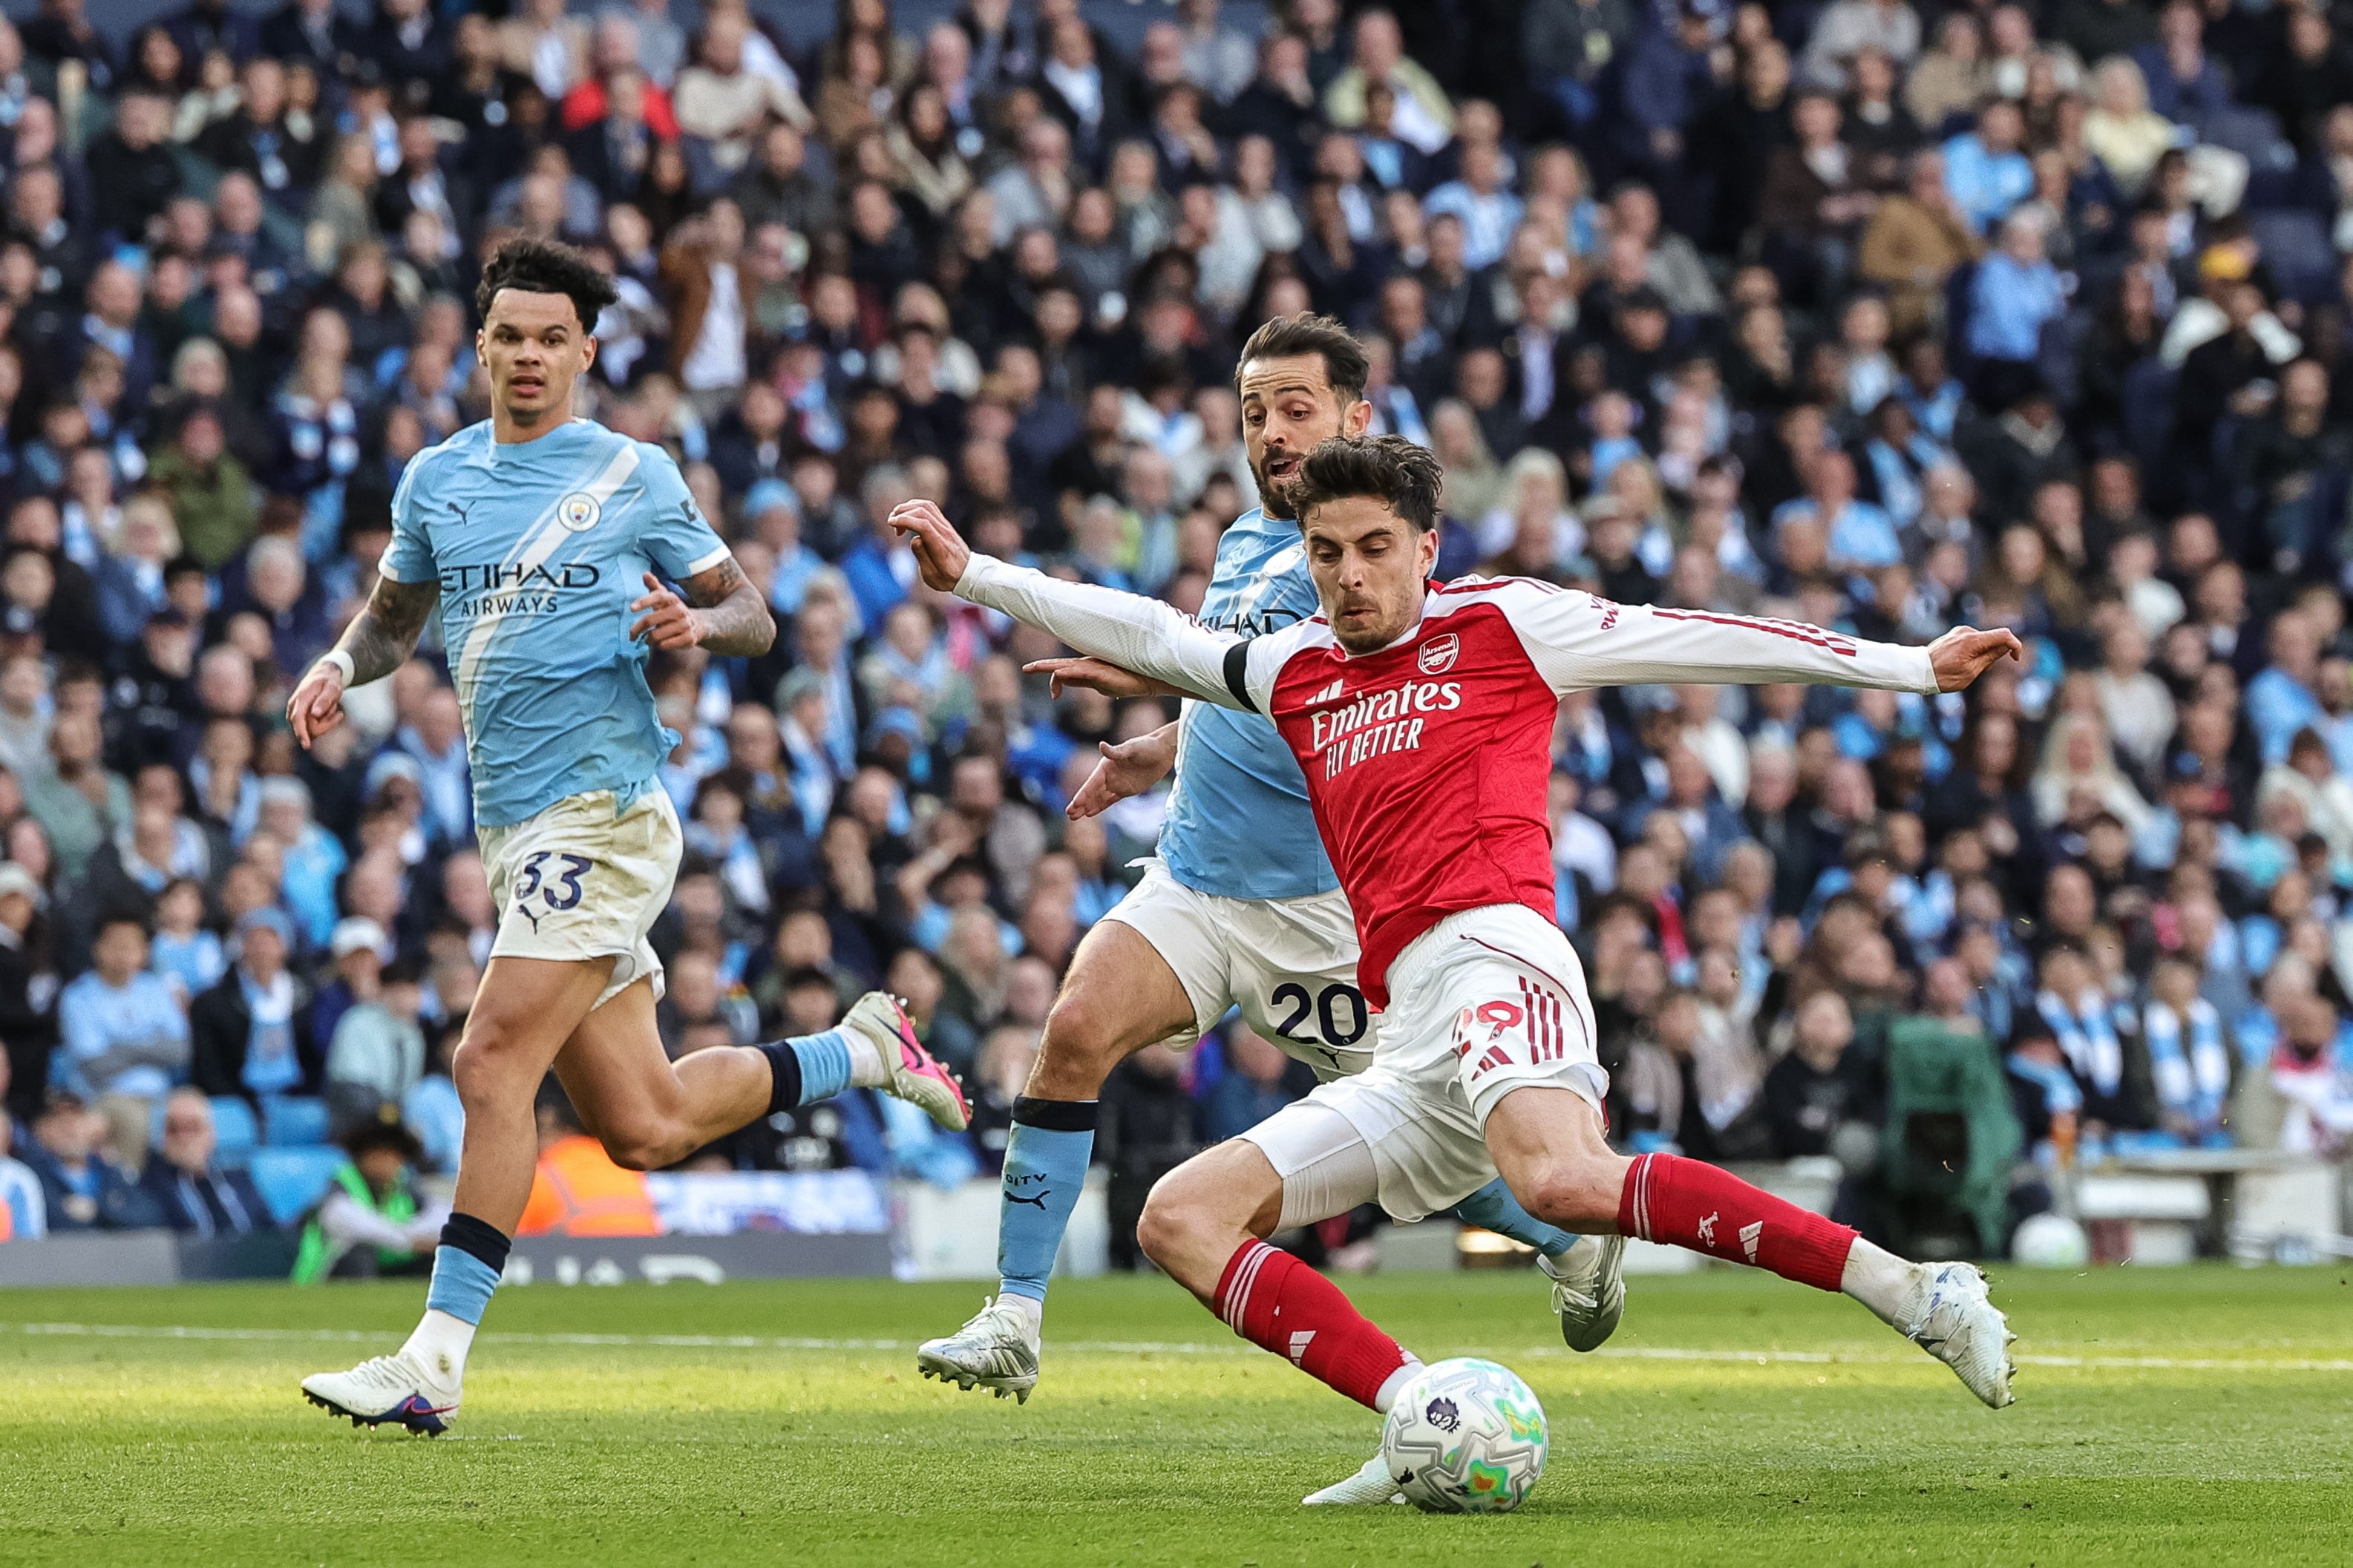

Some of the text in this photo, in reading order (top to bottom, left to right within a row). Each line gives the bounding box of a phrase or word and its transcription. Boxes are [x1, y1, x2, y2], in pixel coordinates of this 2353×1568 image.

[439, 562, 600, 592] ETIHAD
[461, 596, 558, 617] AIRWAYS
[1425, 640, 1453, 657] Arsenal
[1310, 679, 1462, 752] Emirates
[1326, 718, 1424, 781] FLY BETTER
[514, 850, 592, 911] 33
[1271, 982, 1368, 1047] 20
